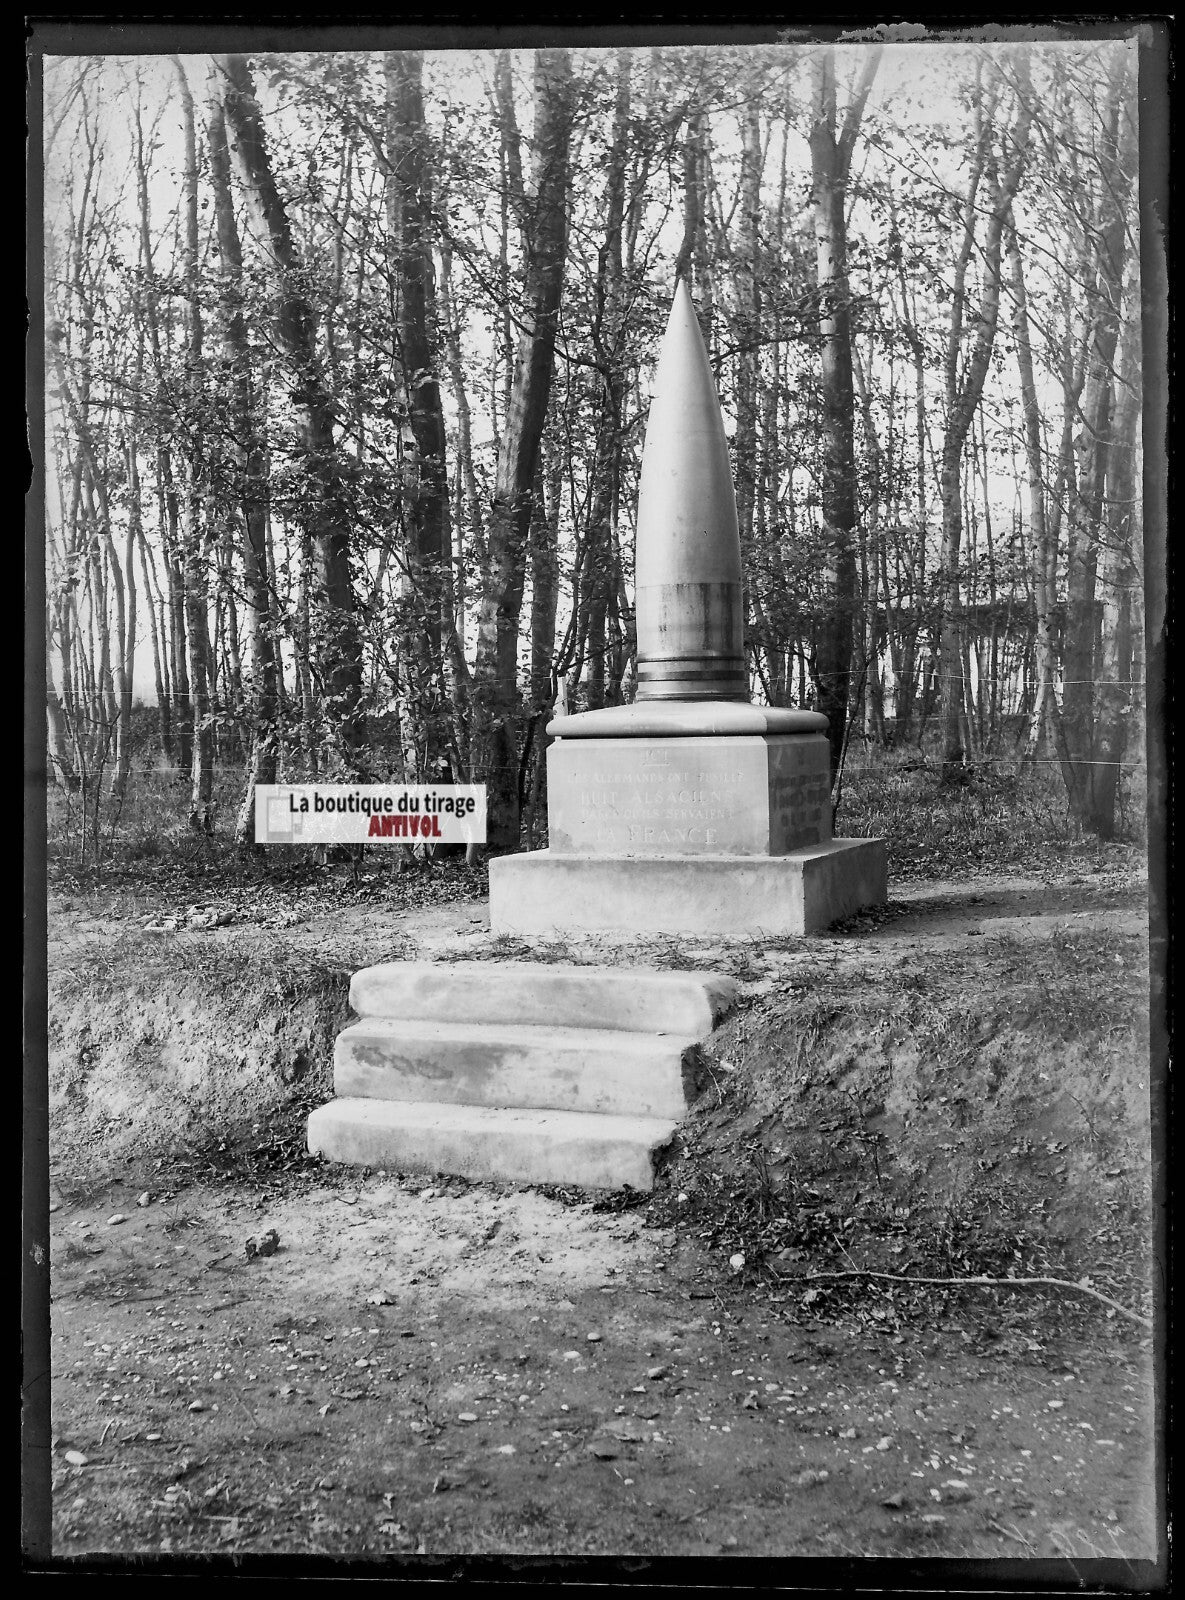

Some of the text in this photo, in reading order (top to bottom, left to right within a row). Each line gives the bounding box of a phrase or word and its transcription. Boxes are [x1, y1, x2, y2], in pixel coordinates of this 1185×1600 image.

[644, 749, 669, 761] ICI
[667, 772, 689, 783] ONT
[580, 791, 618, 805] HUIT
[596, 825, 718, 845] LA FRANCE
